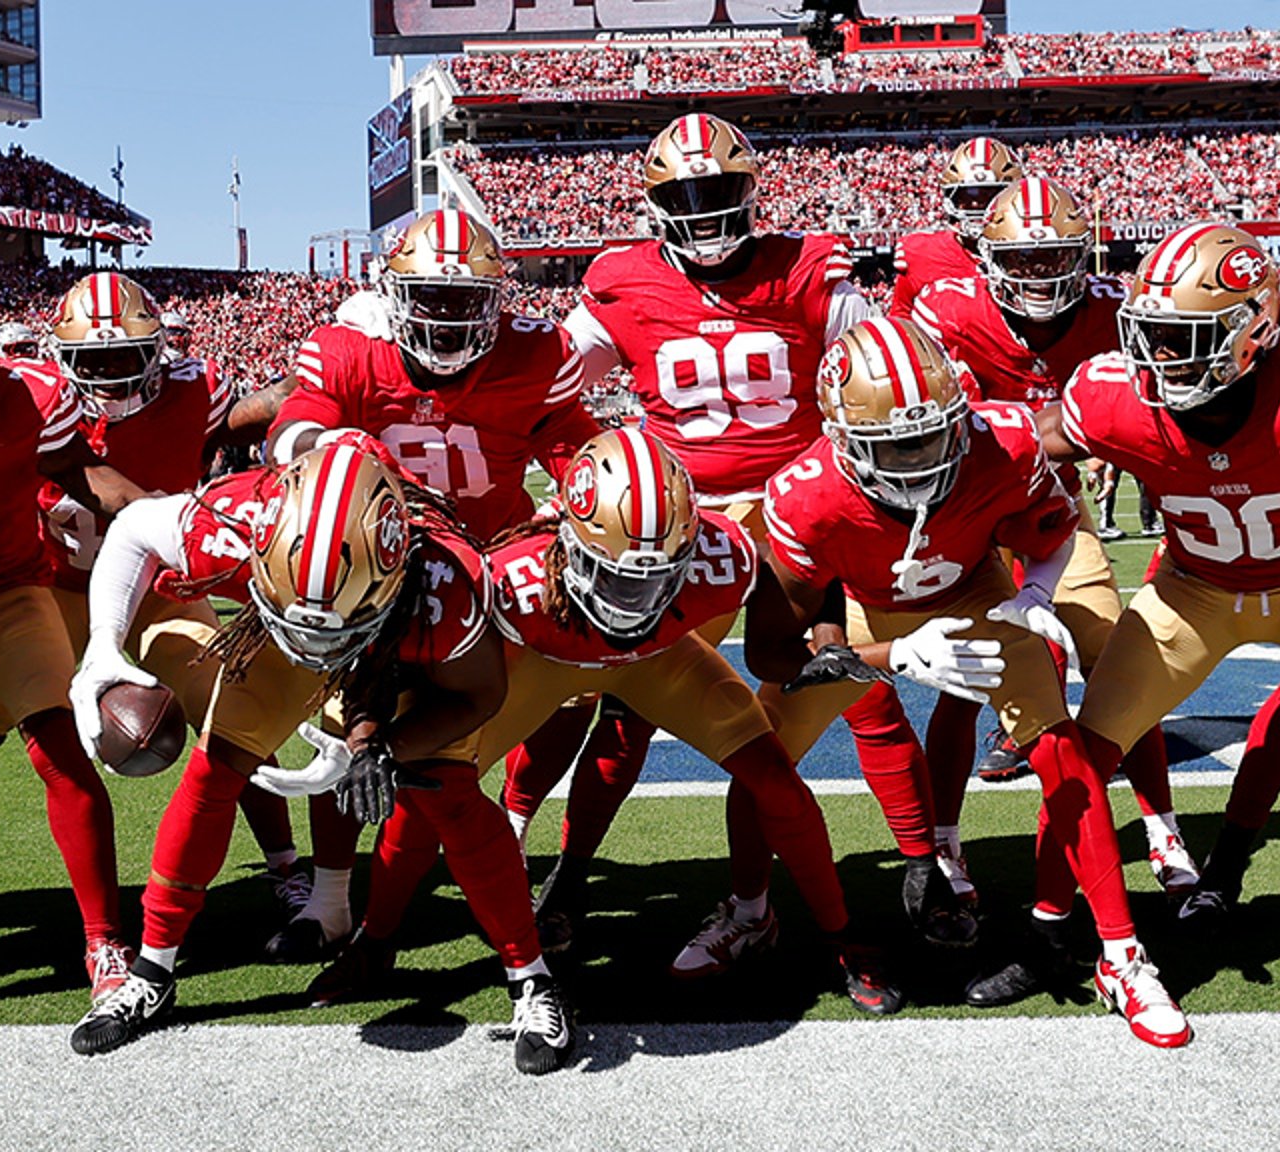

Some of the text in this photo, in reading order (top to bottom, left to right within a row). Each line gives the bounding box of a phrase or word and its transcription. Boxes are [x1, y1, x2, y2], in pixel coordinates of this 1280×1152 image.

[671, 28, 730, 40] Industrial
[733, 27, 783, 39] Internet
[655, 331, 798, 438] 99
[379, 422, 497, 498] 91
[773, 457, 823, 496] 2
